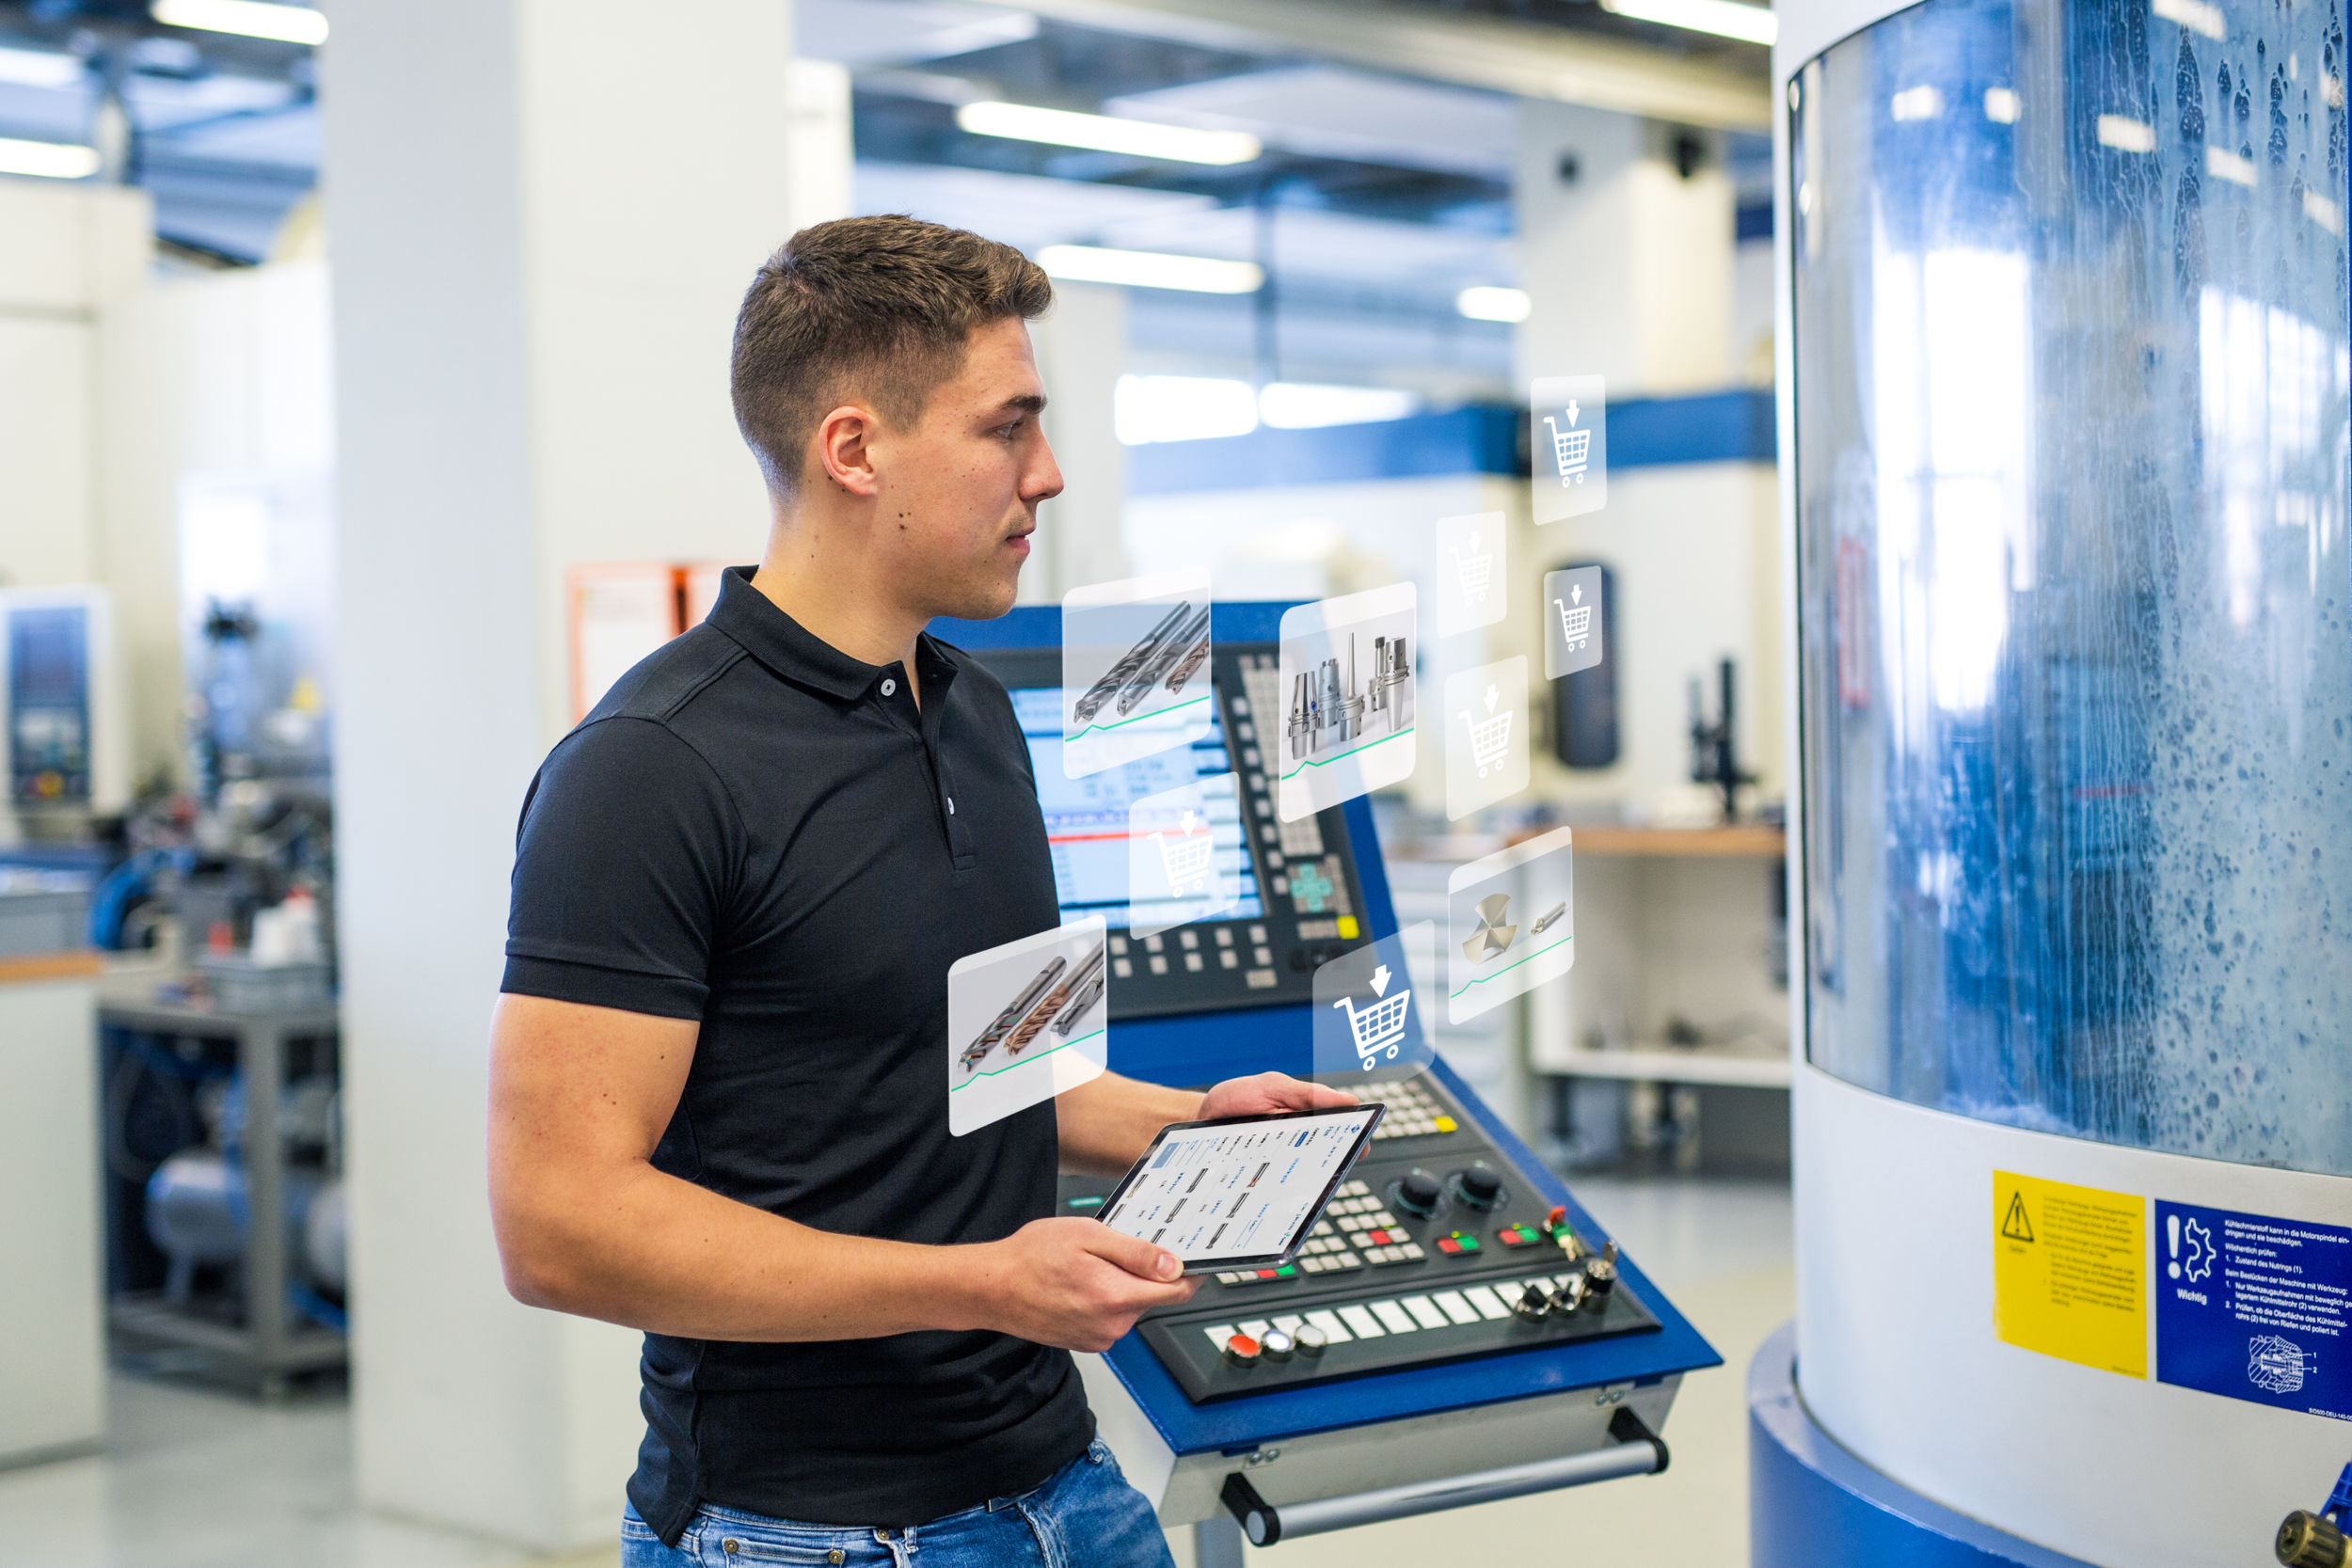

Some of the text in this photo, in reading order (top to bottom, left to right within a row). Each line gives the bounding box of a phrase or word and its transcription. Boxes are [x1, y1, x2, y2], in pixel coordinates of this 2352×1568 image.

[2225, 1220, 2269, 1232] Kühlschmierstoff
[2300, 1231, 2337, 1243] Motorspindel
[2266, 1235, 2303, 1246] beschädigen.
[2225, 1243, 2277, 1257] Wöchentlich prüfen:
[2235, 1256, 2257, 1266] Zustand
[2269, 1262, 2292, 1273] Nutrings
[2225, 1269, 2239, 1277] Beim
[2240, 1271, 2268, 1282] Bestücken
[2279, 1278, 2306, 1288] Maschine
[2317, 1285, 2348, 1295] Werkzeug:
[2177, 1288, 2207, 1305] Wichtig
[2235, 1292, 2259, 1301] lagertem
[2260, 1296, 2297, 1307] Kühlmittelrohr
[2308, 1305, 2341, 1315] verwenden.
[2247, 1285, 2304, 1299] Werkzeugaufnahmen
[2315, 1296, 2344, 1306] beweglich
[2235, 1303, 2255, 1312] Prüfen,
[2273, 1310, 2304, 1321] Oberfläche
[2317, 1317, 2348, 1327] Kühlmittel-
[2280, 1320, 2299, 1329] Riefen
[2312, 1325, 2330, 1334] poliert
